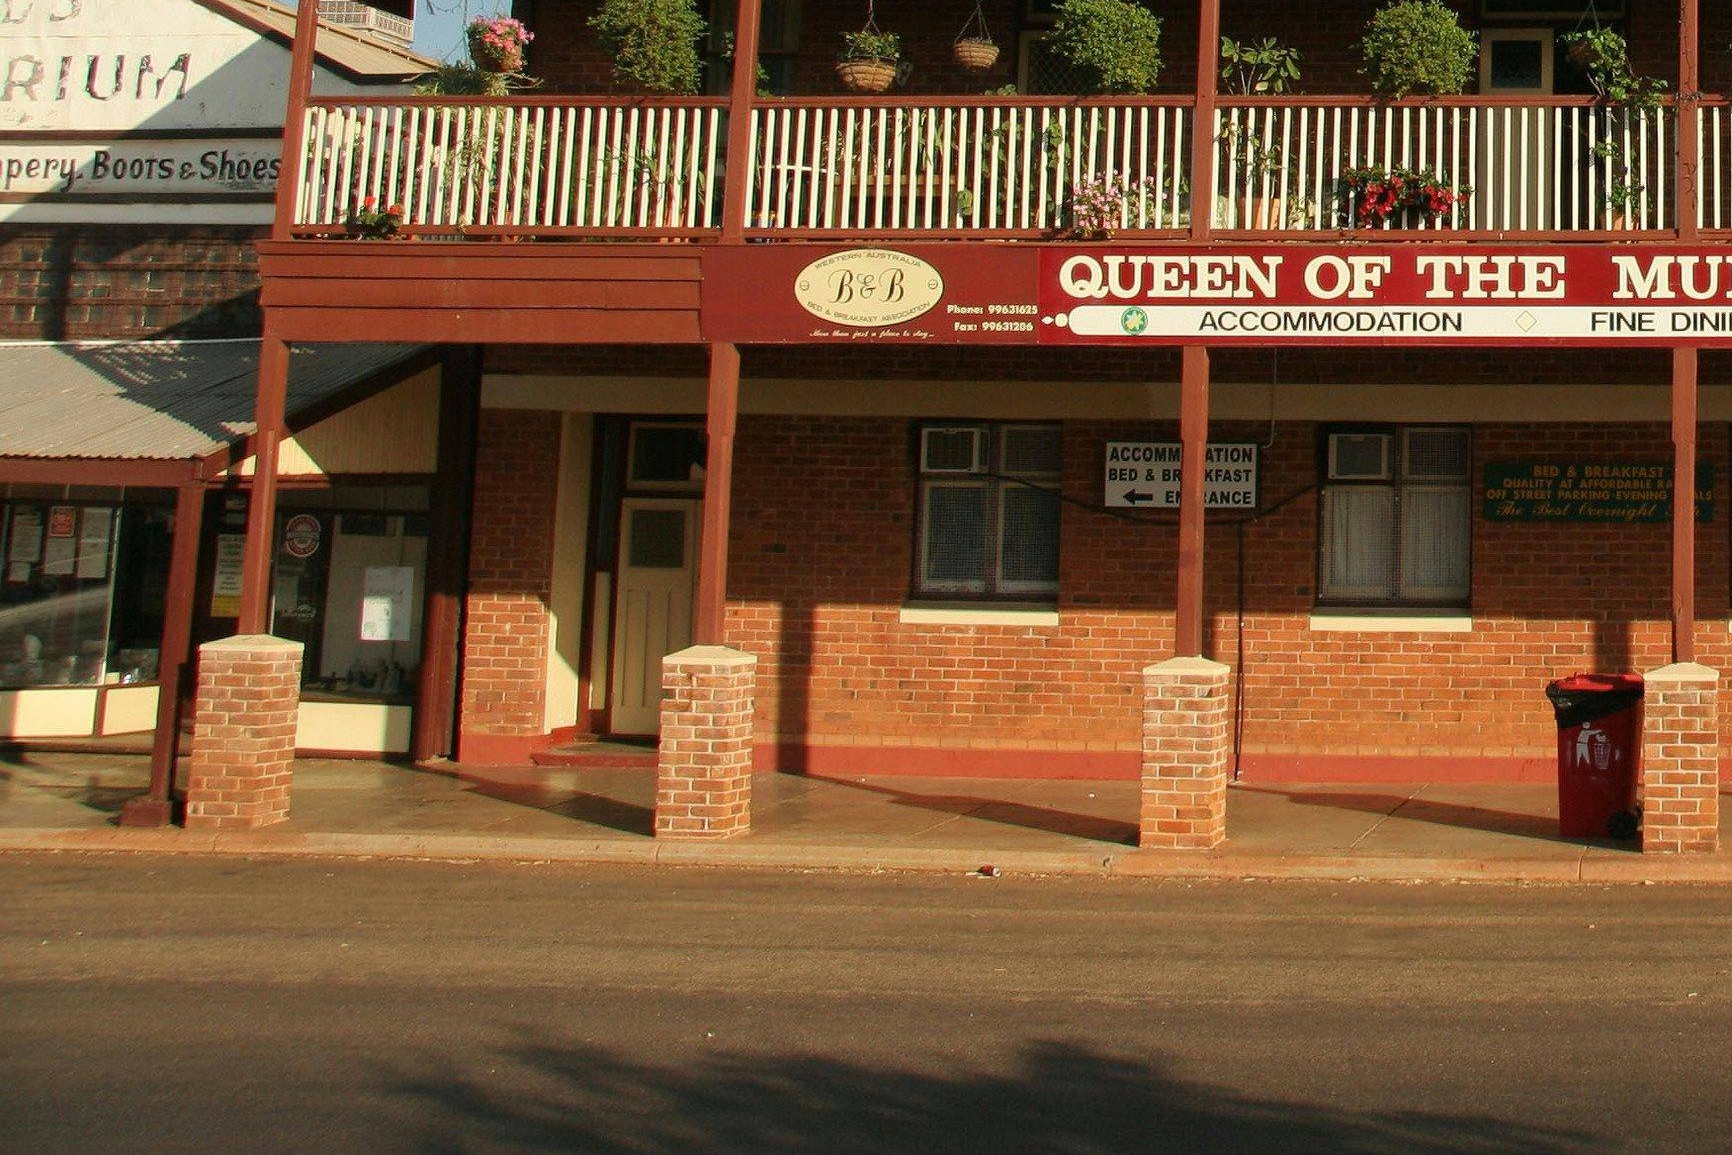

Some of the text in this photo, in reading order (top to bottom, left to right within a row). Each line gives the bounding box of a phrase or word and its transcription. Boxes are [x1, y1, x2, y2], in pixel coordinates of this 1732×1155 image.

[180, 161, 197, 180] &
[200, 148, 283, 181] Shoes
[1059, 254, 1283, 299] QUEEN
[1304, 254, 1391, 299] OF
[1416, 255, 1565, 299] THE
[947, 304, 984, 314] Phone:
[955, 321, 978, 331] Fax:
[1198, 311, 1463, 332] ACCOMMODATION
[1591, 312, 1654, 332] FINE
[1110, 446, 1253, 463] ACCOMMATION
[1108, 468, 1252, 482] BED & BRKFAST
[1533, 465, 1559, 477] BED
[1584, 465, 1665, 478] BREAKFAST
[1165, 490, 1252, 504] EANCE
[1558, 489, 1610, 500] PARKING
[1616, 489, 1668, 500] EVENING
